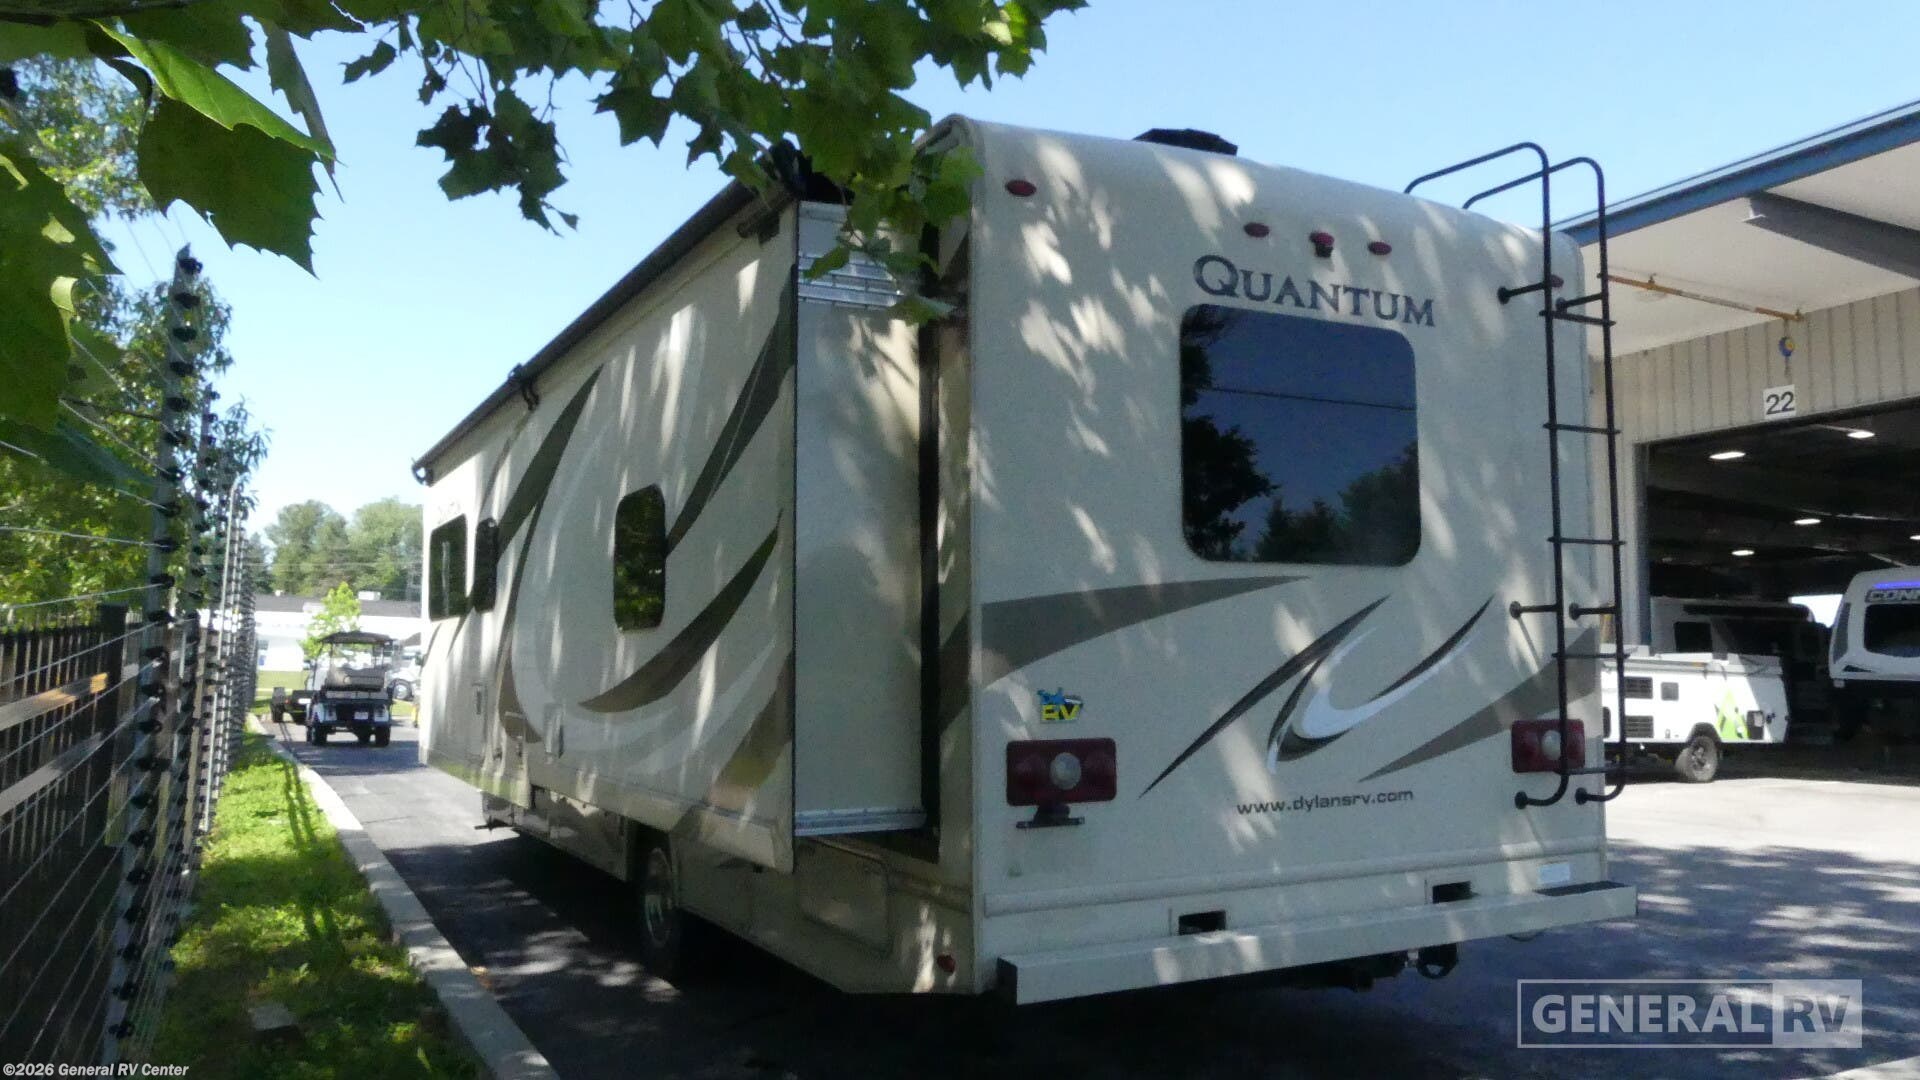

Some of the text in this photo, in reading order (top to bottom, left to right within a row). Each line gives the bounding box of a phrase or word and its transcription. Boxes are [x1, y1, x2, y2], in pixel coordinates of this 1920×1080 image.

[1193, 254, 1435, 327] QUANTUM
[1766, 391, 1795, 415] 22
[1237, 790, 1413, 815] www.dylansrv.com
